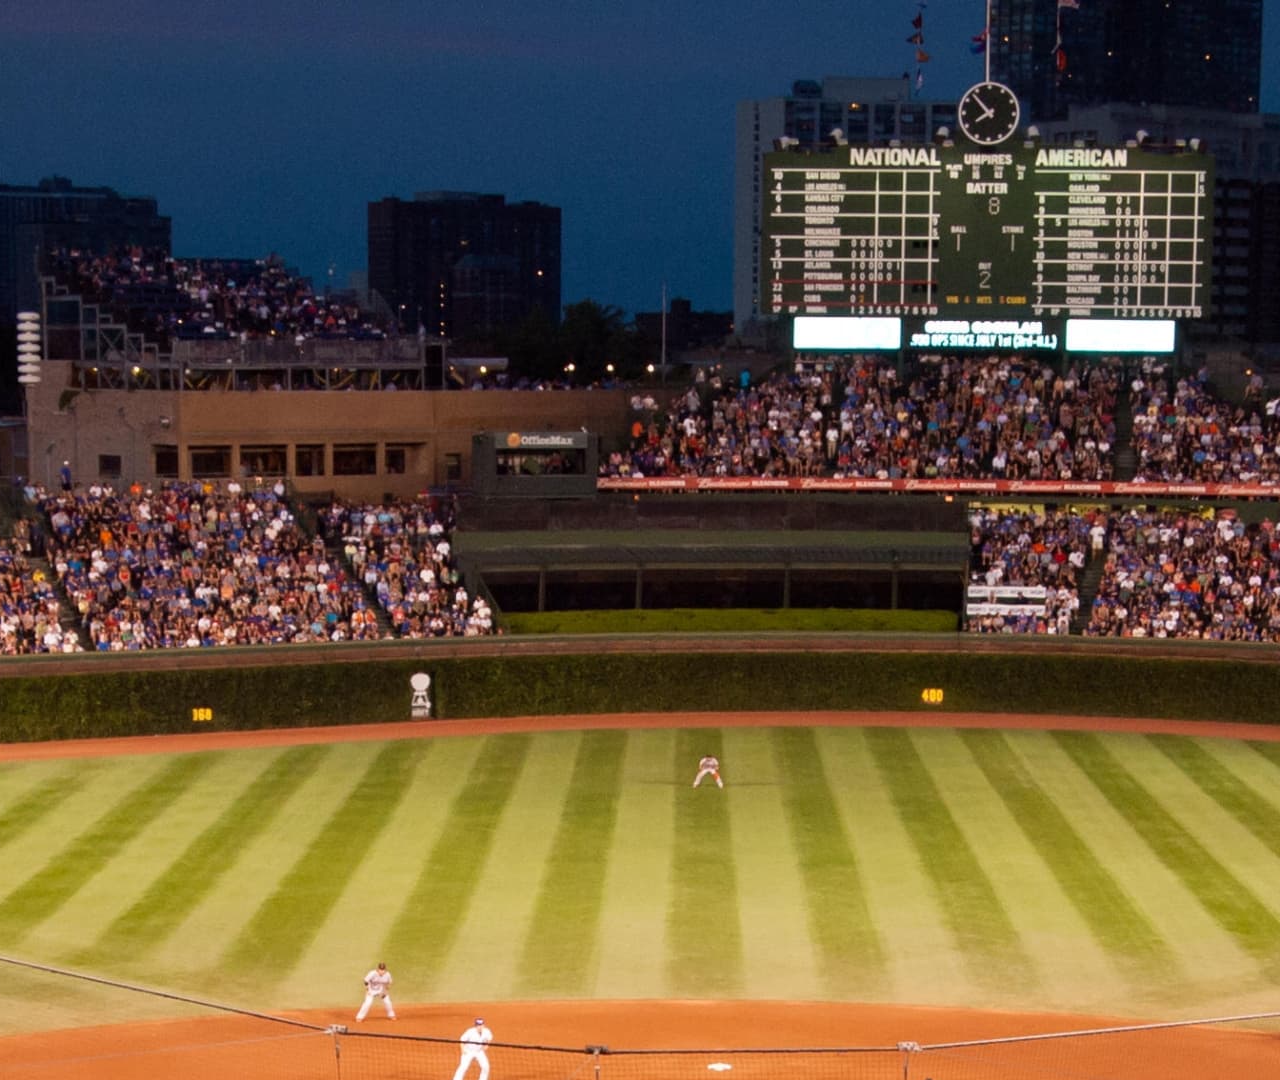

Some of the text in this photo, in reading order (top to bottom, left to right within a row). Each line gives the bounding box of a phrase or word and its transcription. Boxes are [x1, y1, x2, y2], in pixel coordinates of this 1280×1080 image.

[850, 148, 941, 166] NATIONAL
[964, 154, 1012, 165] UMPIRES
[1035, 149, 1127, 167] AMERICAN
[966, 182, 1008, 194] BATTER
[1068, 196, 1107, 204] CLEVELAND
[1116, 196, 1123, 204] 0
[989, 196, 1000, 215] 8
[951, 226, 966, 234] BALL
[1002, 226, 1024, 234] STRIKE
[804, 261, 831, 270] ATLANTA
[978, 262, 992, 270] OUT
[979, 271, 991, 288] 2
[850, 284, 856, 292] 4
[859, 284, 865, 292] 0
[850, 295, 856, 303] 0
[1006, 296, 1027, 304] CUBS
[1066, 297, 1095, 305] CHICAGO
[1122, 297, 1129, 306] 0
[859, 306, 865, 315] 2
[868, 306, 873, 315] 3
[876, 306, 882, 315] 4
[885, 306, 891, 315] 5
[894, 306, 900, 315] 6
[903, 306, 909, 315] 7
[912, 306, 918, 315] 8
[921, 306, 927, 315] 9
[929, 306, 938, 315] 10
[1122, 309, 1128, 317] 2
[1131, 309, 1137, 317] 3
[1140, 309, 1146, 317] 4
[1149, 309, 1155, 317] 5
[1158, 309, 1164, 317] 6
[1167, 309, 1173, 317] 7
[1176, 309, 1182, 317] 8
[1185, 309, 1191, 317] 9
[1192, 309, 1202, 317] 10
[931, 334, 949, 347] OPS
[950, 334, 975, 347] SINCE
[975, 334, 996, 347] JULY
[521, 435, 573, 445] OfficeMax
[597, 477, 647, 488] Budweiser
[697, 478, 750, 488] Budweiser
[800, 478, 853, 489] Budweiser
[904, 479, 958, 490] Budweiser
[1008, 480, 1063, 491] Budweiser
[1113, 483, 1167, 493] Budweiser
[1217, 484, 1271, 495] Budweiser
[922, 688, 944, 703] 400
